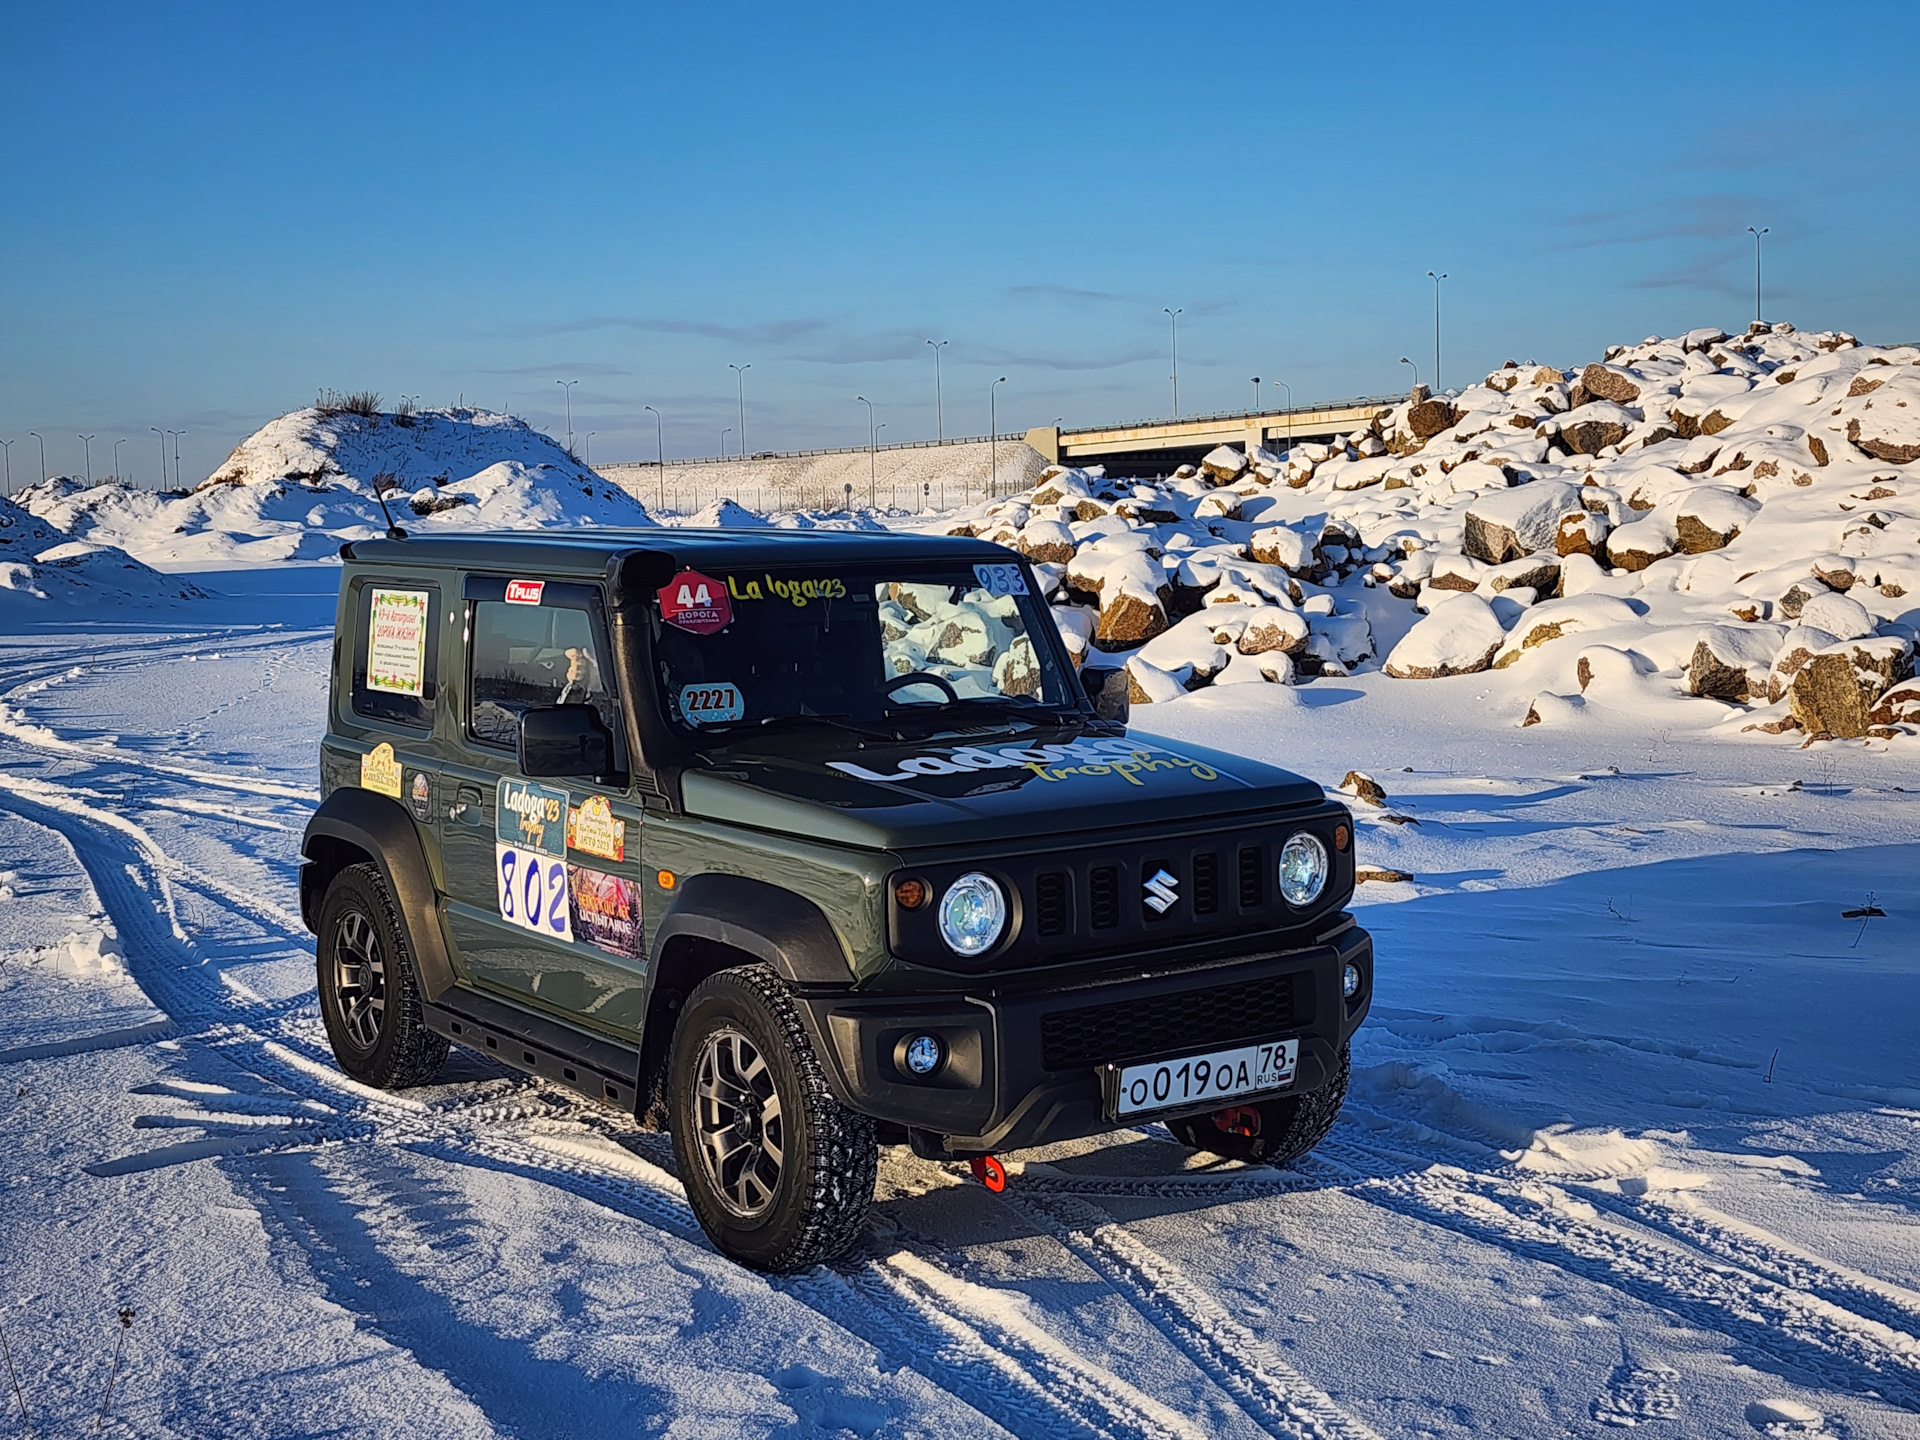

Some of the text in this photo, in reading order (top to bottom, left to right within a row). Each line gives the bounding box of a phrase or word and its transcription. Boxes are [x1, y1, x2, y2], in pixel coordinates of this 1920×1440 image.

[676, 584, 712, 608] 44
[678, 611, 718, 621] ДОРОГА
[686, 689, 735, 711] 2227
[825, 738, 1166, 781] Ladoga
[1020, 750, 1218, 786] trophy
[501, 850, 566, 933] 802
[1260, 1044, 1287, 1074] 78
[1257, 1073, 1277, 1084] RUS
